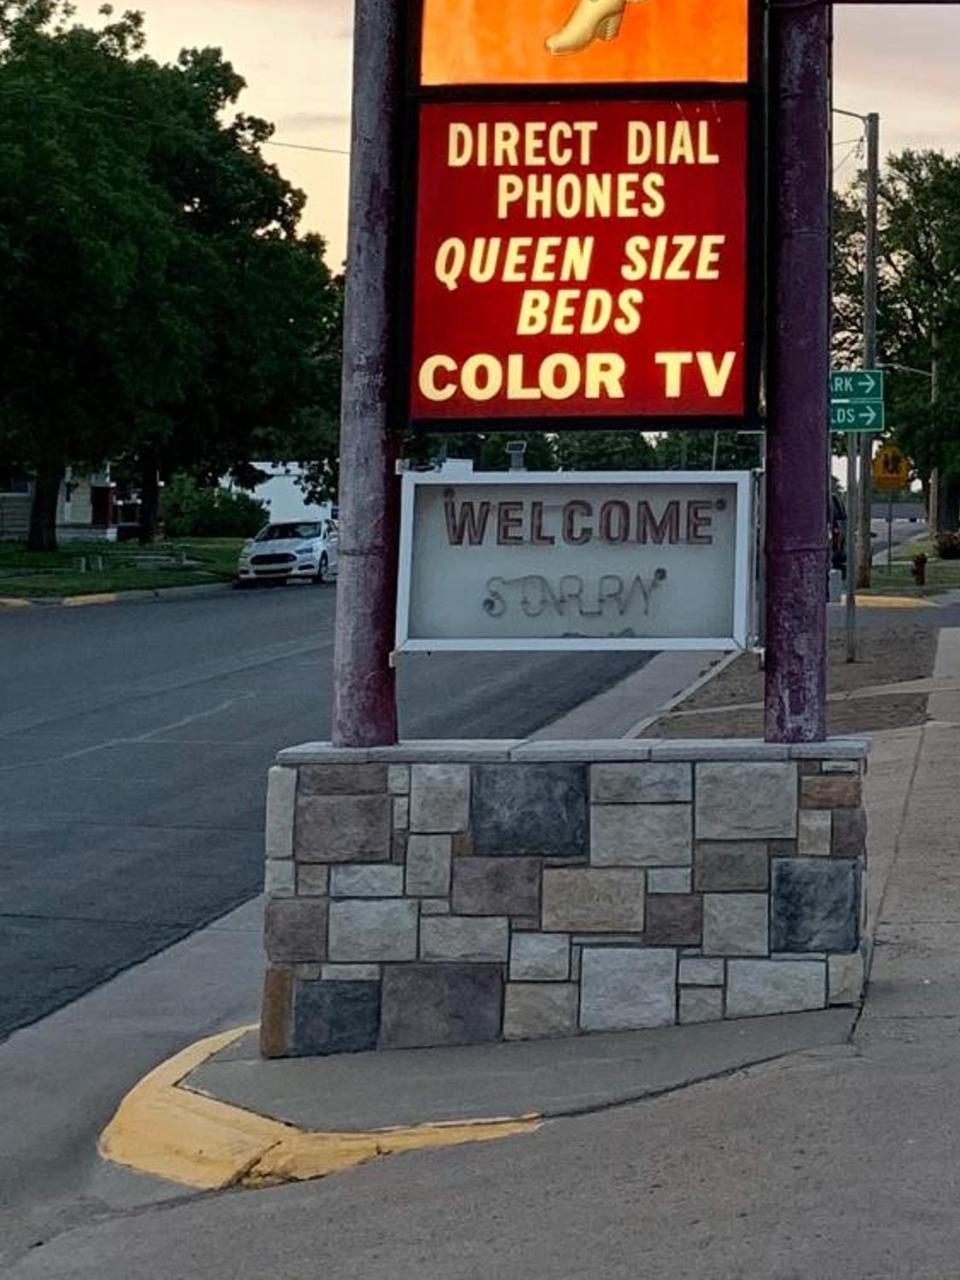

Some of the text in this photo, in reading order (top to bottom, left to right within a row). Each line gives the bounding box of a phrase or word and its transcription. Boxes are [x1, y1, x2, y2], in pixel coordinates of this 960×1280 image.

[448, 120, 720, 167] DIRECT DIAL
[497, 172, 665, 219] PHONES
[434, 235, 725, 291] QUEEN SIZE
[516, 288, 644, 336] BEDS
[418, 351, 737, 401] COLOR TV
[444, 497, 714, 547] WELCOME
